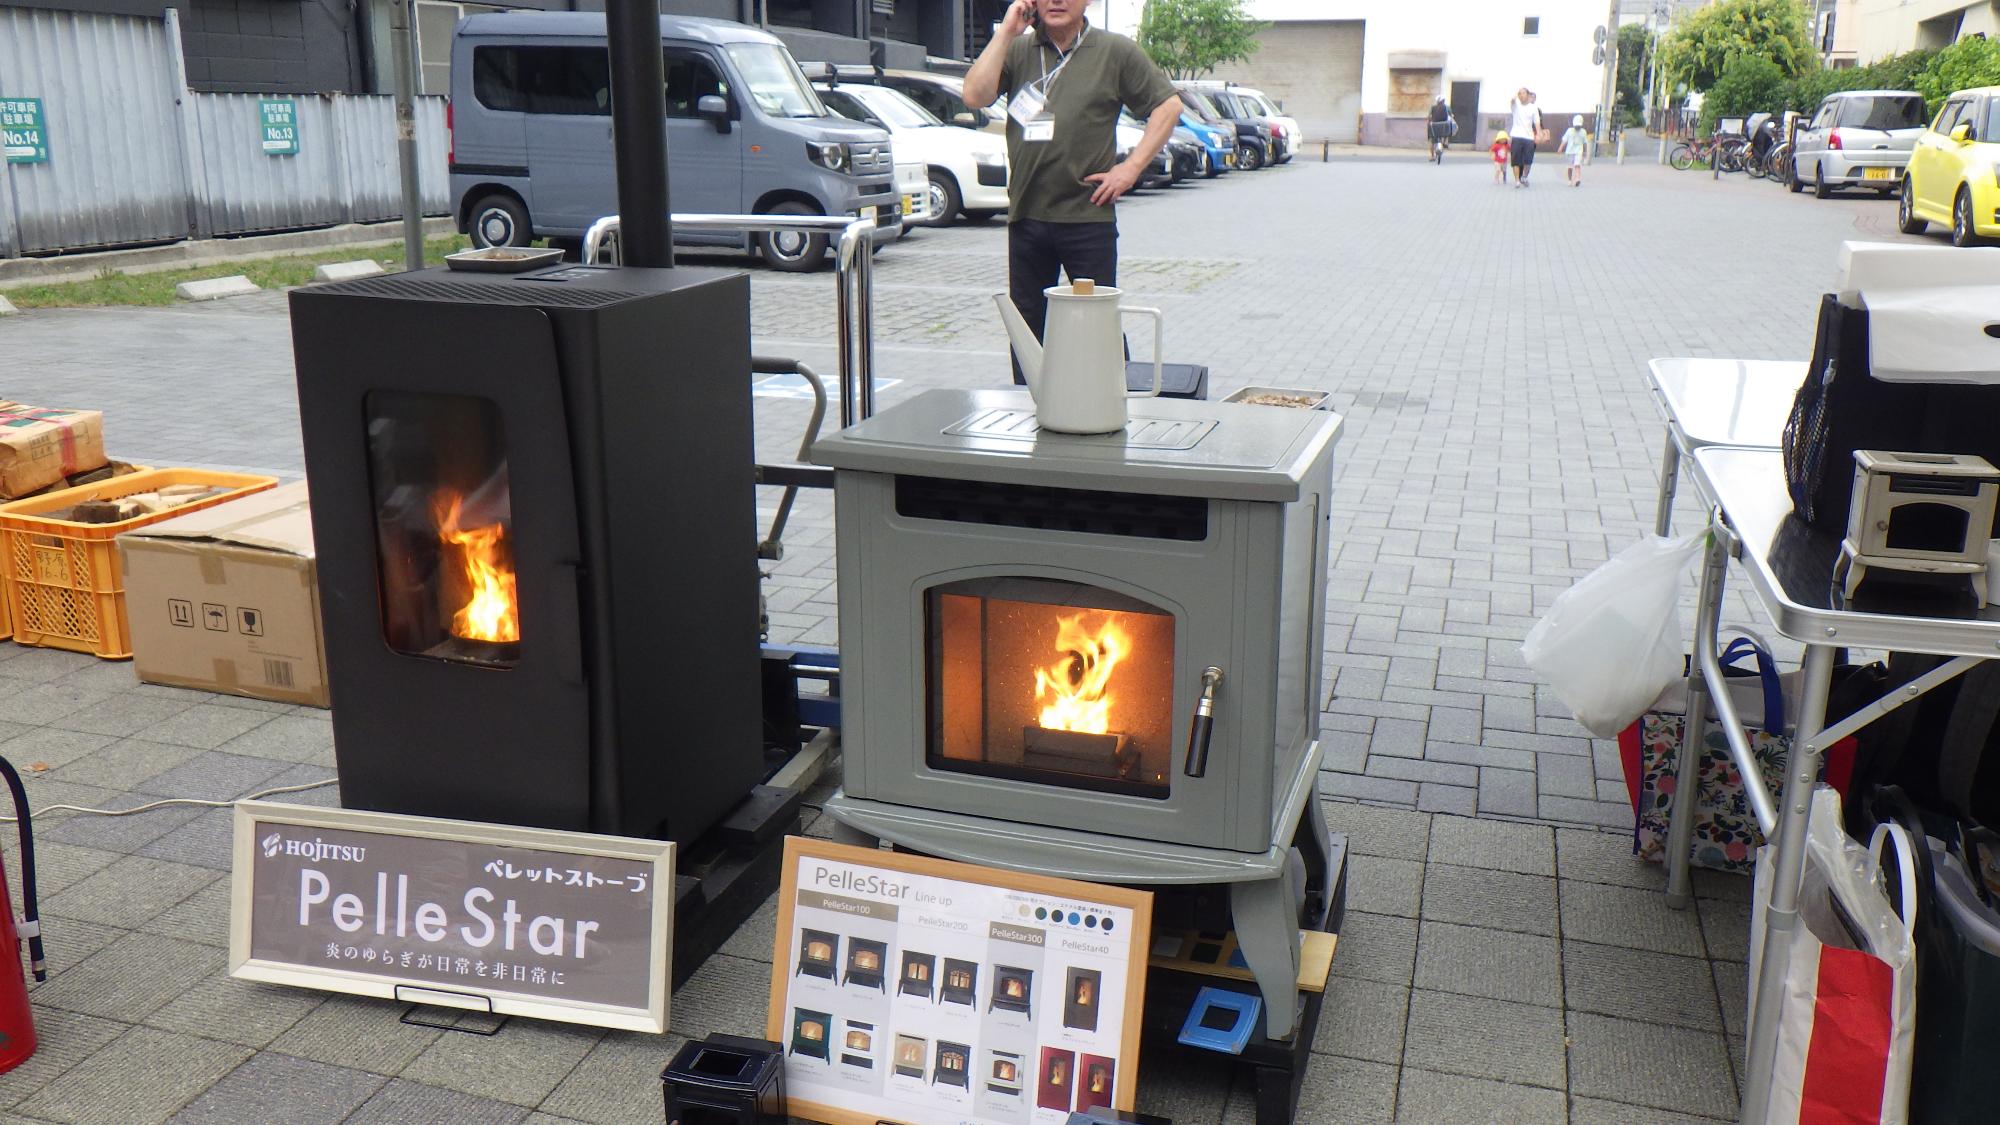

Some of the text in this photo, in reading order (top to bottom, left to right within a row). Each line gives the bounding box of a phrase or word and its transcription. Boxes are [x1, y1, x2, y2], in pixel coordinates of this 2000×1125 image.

[3, 130, 39, 145] No.14
[267, 127, 293, 140] No.13
[484, 859, 648, 893] ペレットストーブ
[815, 866, 953, 907] PelleStar Line up
[823, 899, 871, 914] PelleStar100
[918, 915, 968, 931] PelleStar200
[991, 927, 1043, 944] PelleStar300
[1062, 939, 1110, 954] PelleStar40
[325, 942, 566, 985] 炎のゆらぎが日常を非日常に
